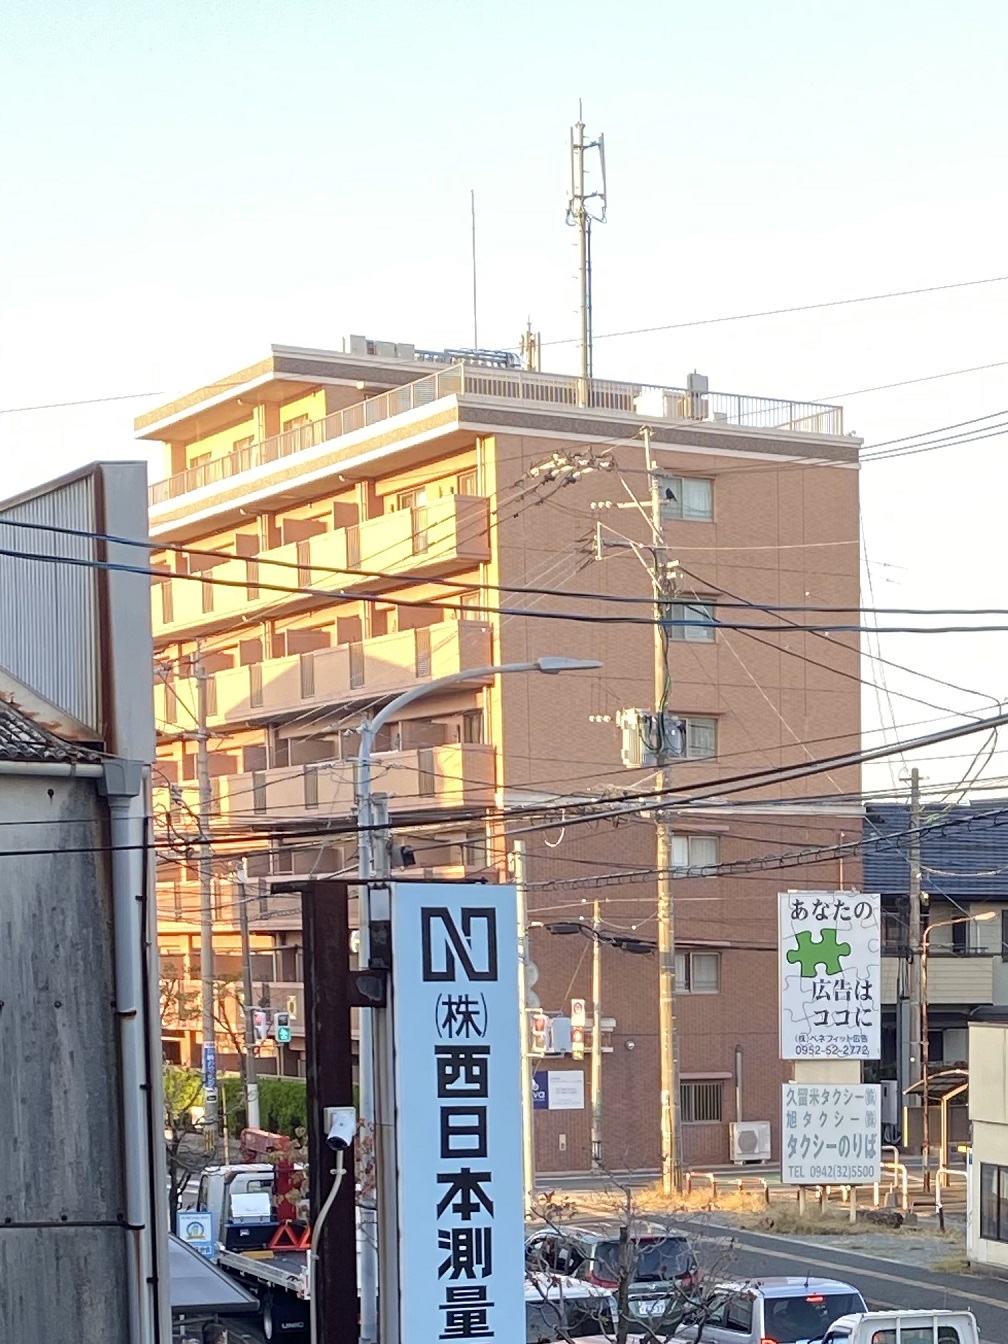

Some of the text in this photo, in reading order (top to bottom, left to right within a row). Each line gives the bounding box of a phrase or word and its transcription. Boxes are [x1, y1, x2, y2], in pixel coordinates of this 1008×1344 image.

[790, 898, 873, 921] あなたの
[812, 978, 873, 1001] 広告は
[813, 1007, 873, 1027] ココに
[795, 1044, 869, 1056] 0952-52-2772
[787, 1133, 877, 1159] タクシーのりば
[788, 1164, 875, 1180] TEL 0942(32)5500
